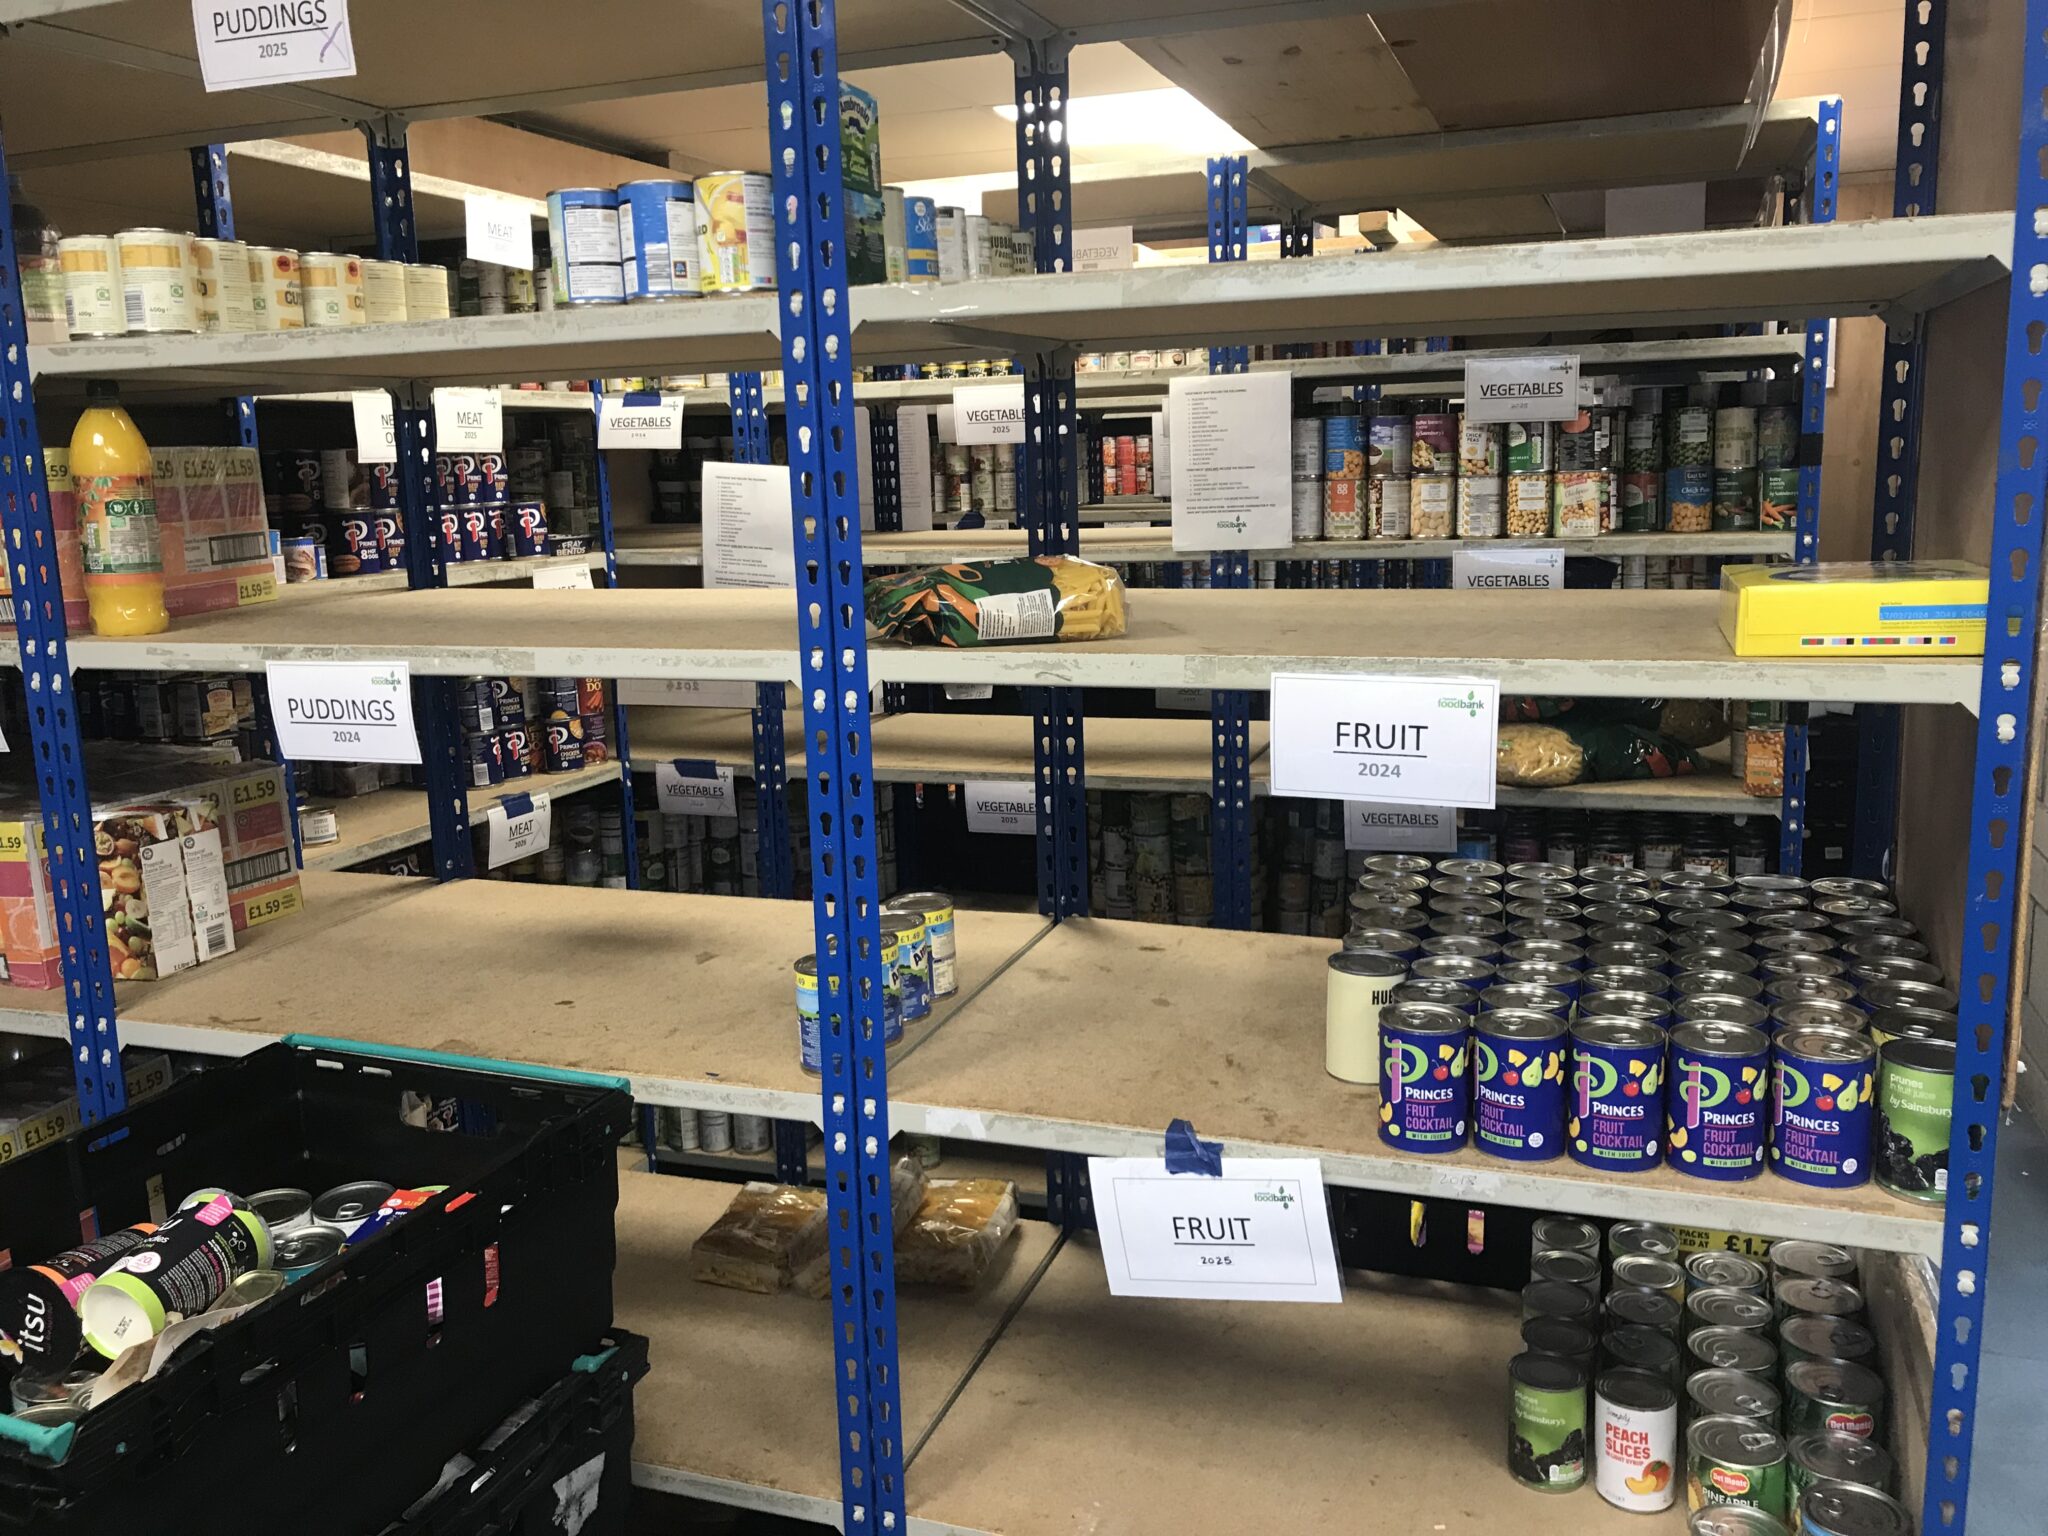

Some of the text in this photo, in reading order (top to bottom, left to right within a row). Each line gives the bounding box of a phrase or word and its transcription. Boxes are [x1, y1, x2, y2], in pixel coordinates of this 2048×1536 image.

[213, 0, 327, 36] PUDDINGS
[258, 42, 288, 58] 2025
[487, 222, 513, 238] MEAT
[1480, 382, 1563, 396] VEGETABLES
[457, 411, 483, 426] MEAT
[610, 416, 672, 429] VEGETABLES
[966, 409, 1026, 422] VEGETABLE
[464, 431, 477, 439] 2025
[992, 426, 1011, 434] 2025
[1216, 520, 1247, 529] foodbank
[556, 546, 586, 556] BENTOS
[562, 540, 583, 548] FRAY
[1467, 575, 1550, 587] VEGETABLES
[240, 582, 262, 600] £1.59
[370, 677, 402, 686] foodbank
[288, 698, 396, 721] PUDDINGS
[1437, 698, 1485, 710] foodbank
[333, 731, 361, 743] 2024
[1336, 722, 1429, 751] FRUIT
[1358, 762, 1402, 778] 2024
[233, 779, 276, 804] £1.59
[666, 783, 724, 797] VEGETABLES
[977, 800, 1037, 813] VEGETABLE
[1000, 816, 1019, 824] 2025
[1362, 812, 1440, 826] VEGETABLES
[509, 819, 534, 838] MEAT
[248, 899, 280, 920] £1.59
[1890, 1073, 1923, 1089] prunes
[1404, 1087, 1453, 1101] PRINCES
[1480, 1085, 1525, 1107] PRINCES
[1889, 1094, 1900, 1109] by
[1405, 1105, 1435, 1118] FRUIT
[1481, 1103, 1504, 1121] FRUIT
[1592, 1101, 1644, 1117] PRINCES
[1405, 1116, 1454, 1130] COCKTAIL
[1703, 1111, 1755, 1126] PRINCES
[1785, 1111, 1840, 1132] PRINCES
[24, 1116, 65, 1149] £1.59
[1480, 1116, 1526, 1137] COCKTAIL
[1593, 1120, 1625, 1135] FRUIT
[1429, 1132, 1447, 1140] JUICE
[1484, 1132, 1516, 1146] WITH JUICE
[1592, 1133, 1645, 1148] COCKTAIL
[1704, 1129, 1737, 1143] FRUIT
[1785, 1129, 1817, 1148] FRUIT
[1599, 1150, 1616, 1158] WITH
[1703, 1142, 1754, 1157] COCKTAIL
[1785, 1141, 1840, 1164] COCKTAIL
[1790, 1160, 1829, 1173] WITH JUICE
[1254, 1193, 1295, 1203] foodbank
[1172, 1216, 1251, 1240] FRUIT
[1680, 1229, 1710, 1240] PACKS
[1201, 1256, 1232, 1265] 2025
[17, 1293, 46, 1352] itsu
[1605, 1421, 1648, 1445] PEACH
[1830, 1420, 1872, 1431] Del Monte
[1605, 1437, 1651, 1460] SLICES
[1712, 1472, 1748, 1489] Del Monte
